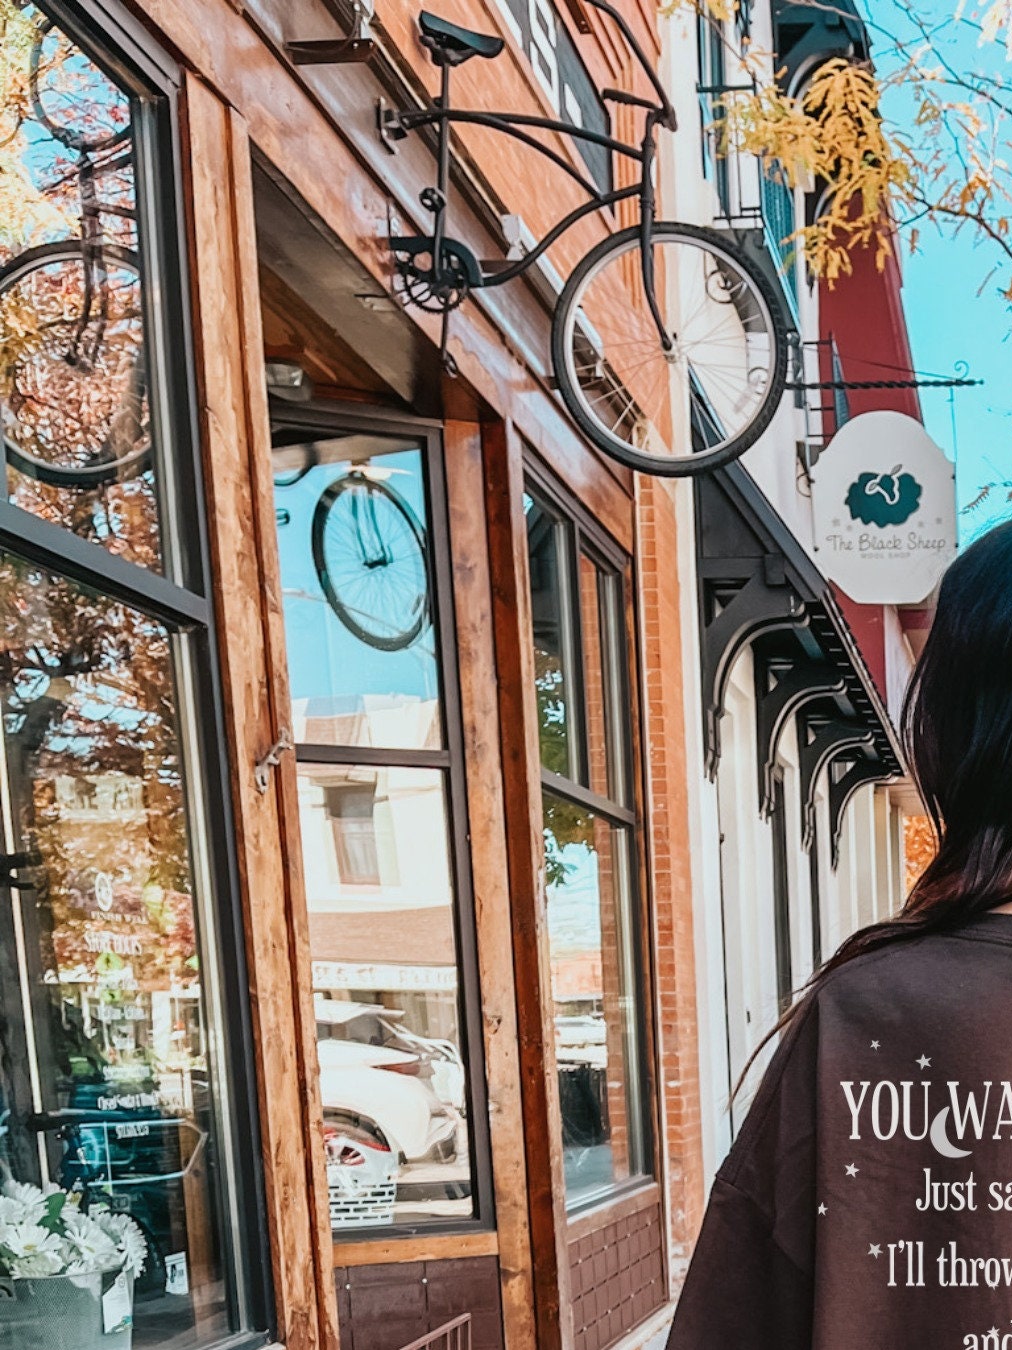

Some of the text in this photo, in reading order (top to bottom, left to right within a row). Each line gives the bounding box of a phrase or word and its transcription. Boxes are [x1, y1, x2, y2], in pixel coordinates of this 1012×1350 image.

[826, 531, 946, 553] The Black Sheep
[840, 1081, 930, 1140] YOU
[915, 1168, 977, 1211] Just
[887, 1240, 925, 1287] I'll
